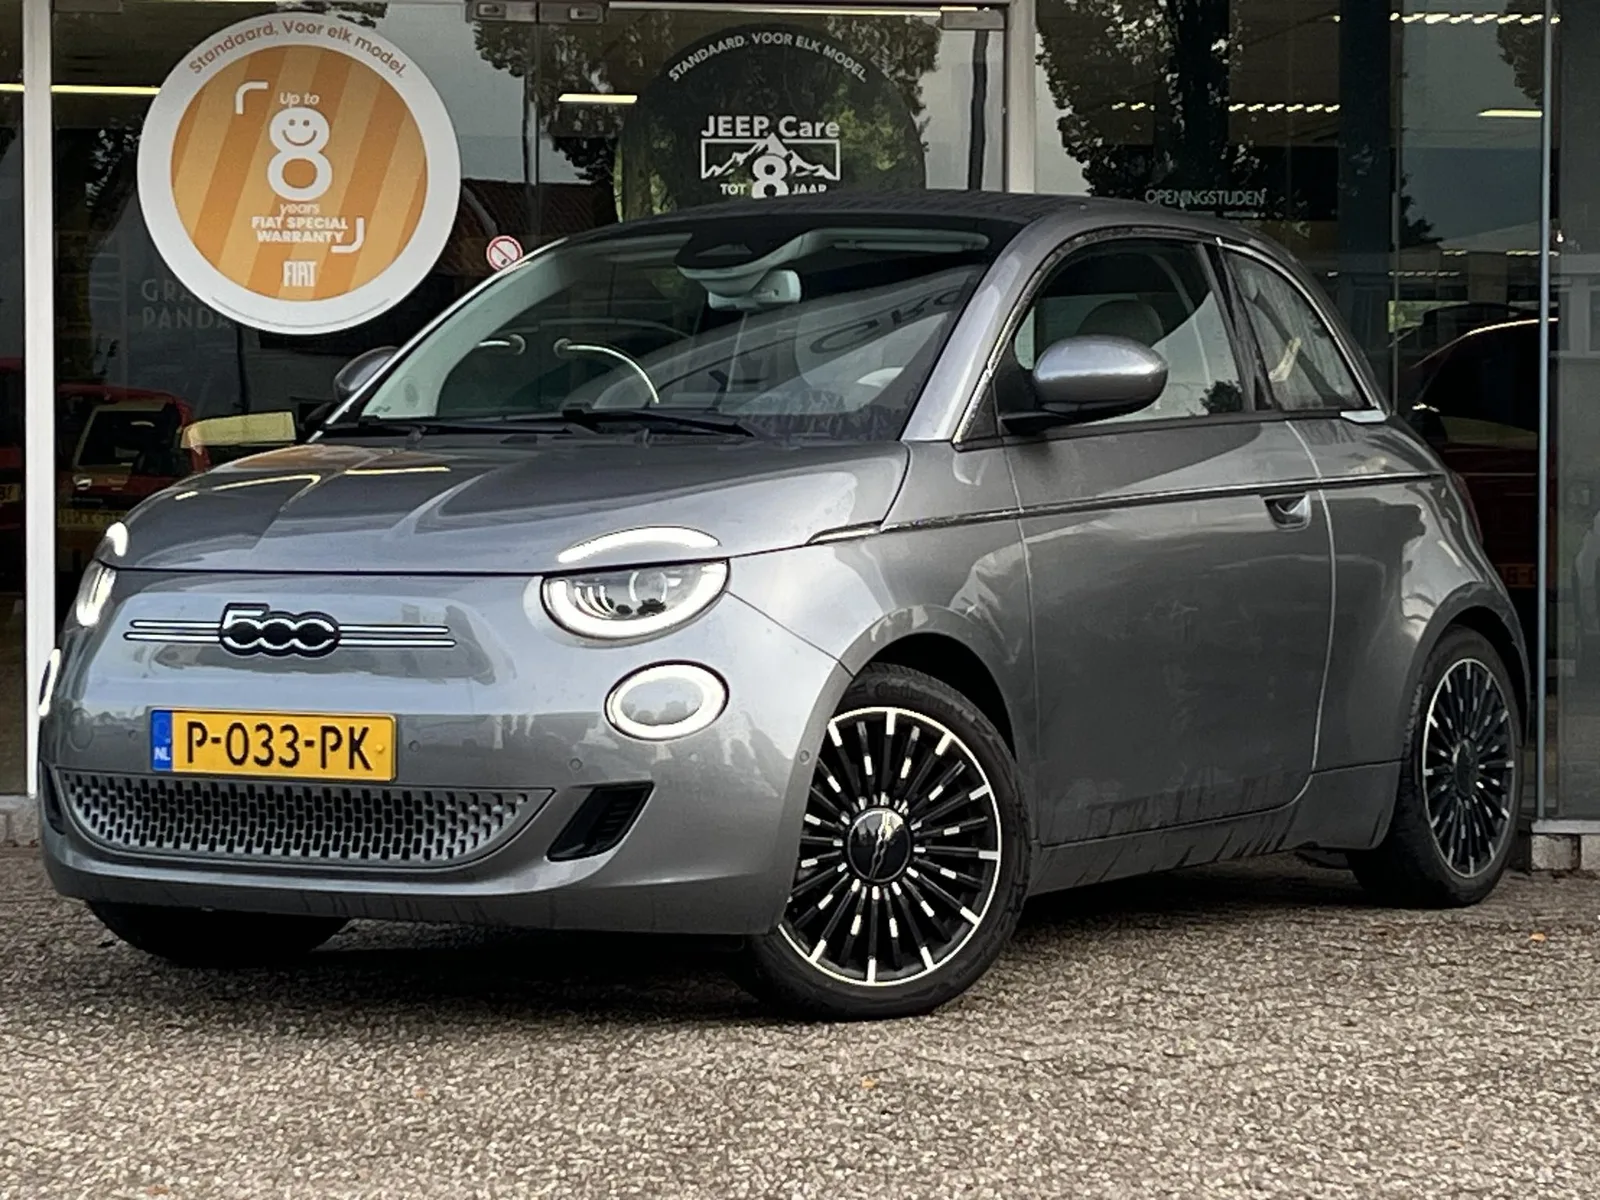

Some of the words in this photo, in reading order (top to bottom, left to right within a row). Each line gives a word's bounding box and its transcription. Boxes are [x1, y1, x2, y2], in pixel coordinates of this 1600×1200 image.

[281, 20, 323, 34] Voor
[327, 27, 352, 43] elk
[751, 32, 792, 45] VOOR
[795, 36, 821, 53] ELK
[279, 92, 300, 108] Up
[304, 93, 320, 105] to
[779, 115, 840, 138] Care
[267, 107, 333, 202] 8
[720, 183, 747, 195] TOT
[752, 155, 789, 199] 8
[252, 216, 284, 229] FIAT
[287, 216, 348, 230] SPECIAL
[280, 204, 321, 219] years
[256, 231, 345, 244] WARRANTY
[283, 260, 317, 287] FIAT
[220, 606, 338, 654] 500
[154, 747, 171, 761] NL
[187, 721, 372, 771] P-033-PK
